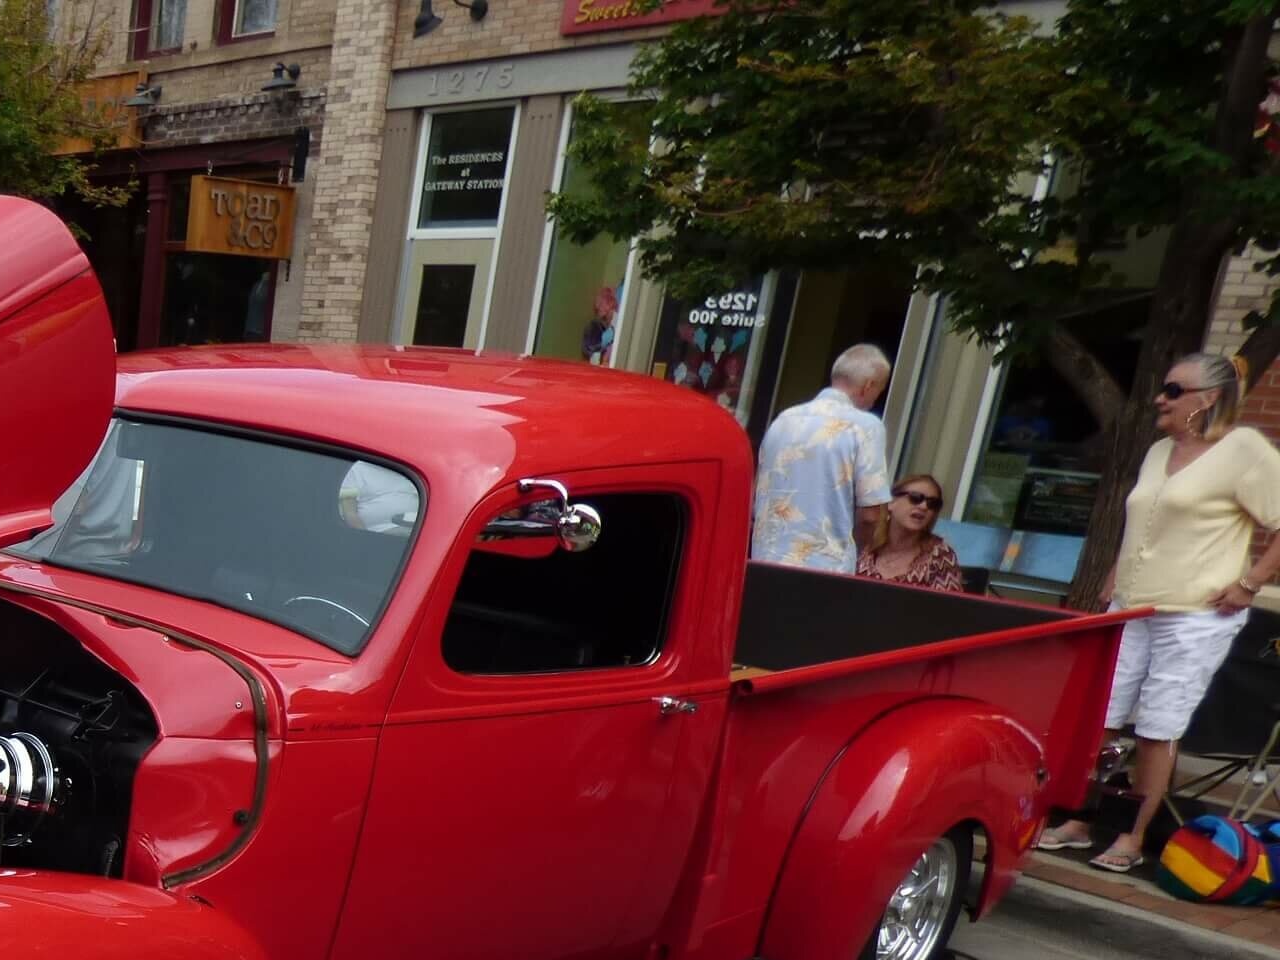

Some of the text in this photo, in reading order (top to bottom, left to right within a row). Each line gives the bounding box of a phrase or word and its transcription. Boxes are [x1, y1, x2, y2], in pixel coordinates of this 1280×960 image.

[427, 63, 513, 97] 1275
[432, 152, 504, 165] The RESIDENCES
[461, 168, 471, 177] at
[424, 180, 465, 191] GATEWAY
